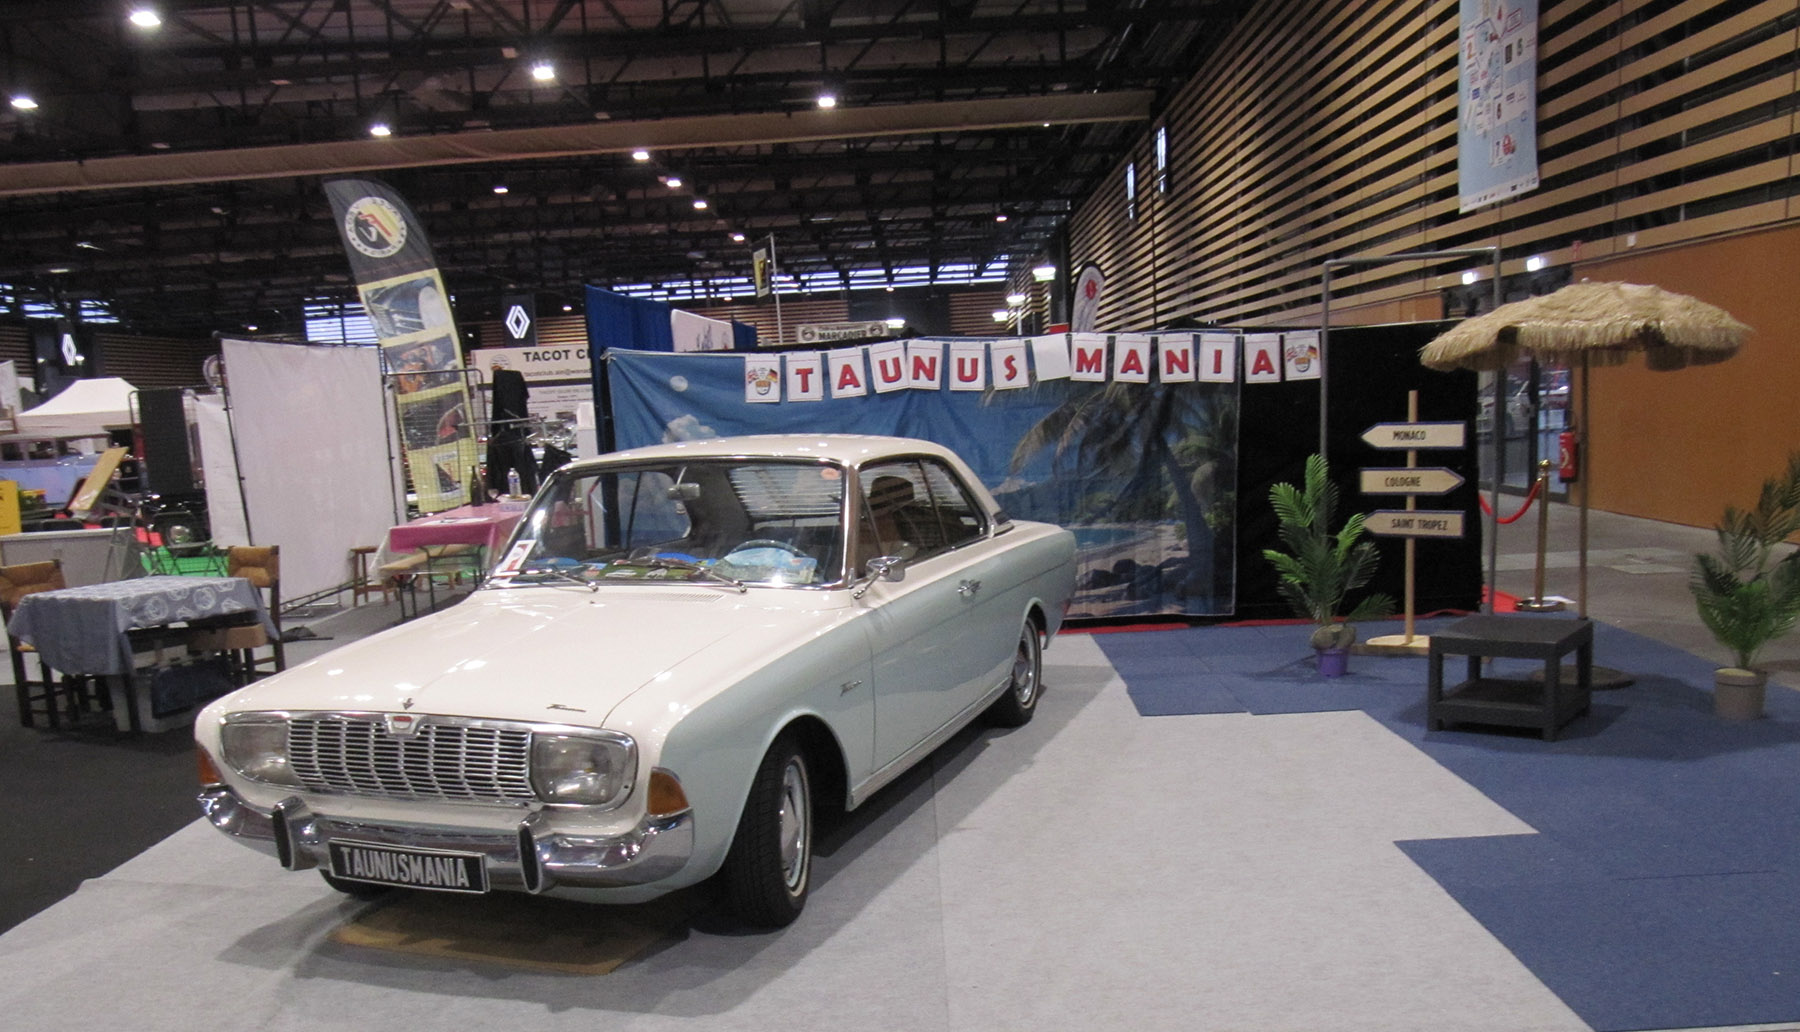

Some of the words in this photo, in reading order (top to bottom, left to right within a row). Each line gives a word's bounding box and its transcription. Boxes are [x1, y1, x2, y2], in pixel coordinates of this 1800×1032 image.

[523, 349, 571, 362] TACOT
[795, 354, 1016, 393] TAUNUS
[1076, 347, 1275, 375] MANIA
[1393, 430, 1426, 441] MONACO
[1384, 476, 1422, 488] COLOGNE
[1391, 518, 1415, 529] SAINT
[1418, 519, 1449, 531] TROPEZ
[340, 847, 469, 887] TAUNUSMANIA
